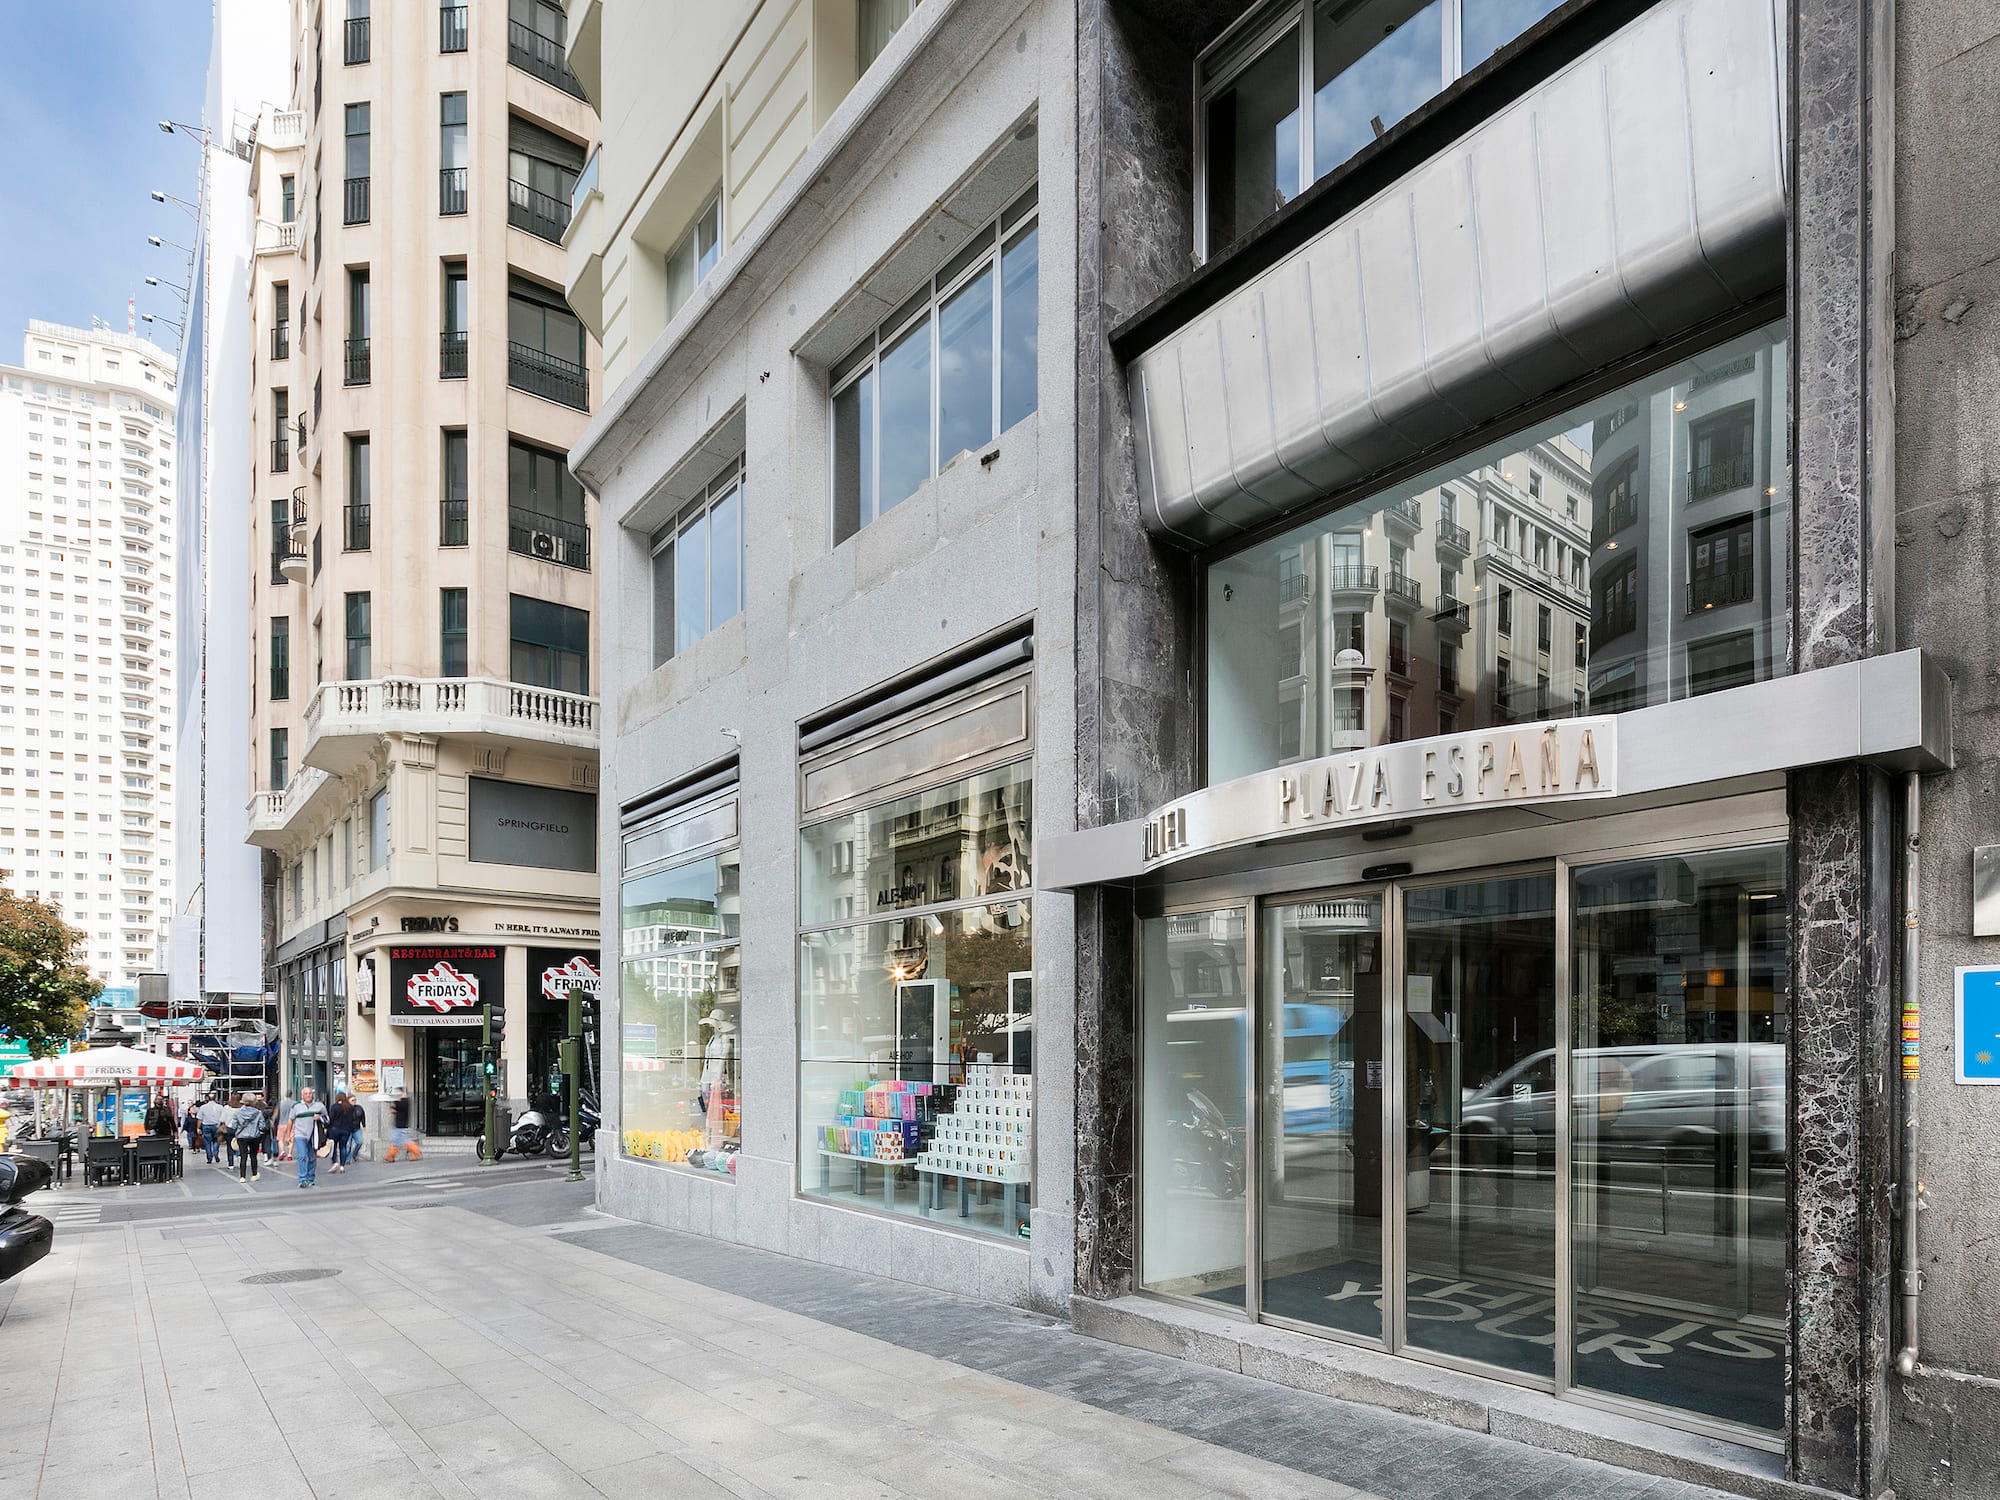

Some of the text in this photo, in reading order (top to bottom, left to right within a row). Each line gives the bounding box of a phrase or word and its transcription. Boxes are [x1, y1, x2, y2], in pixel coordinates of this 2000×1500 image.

[1279, 724, 1600, 824] PLAZA ESPAÑA
[497, 817, 569, 834] SPRINGFIELD
[506, 924, 531, 933] HERE,
[532, 925, 548, 933] IT'S
[549, 927, 580, 936] ALWAYS
[554, 978, 600, 991] FRiDAY
